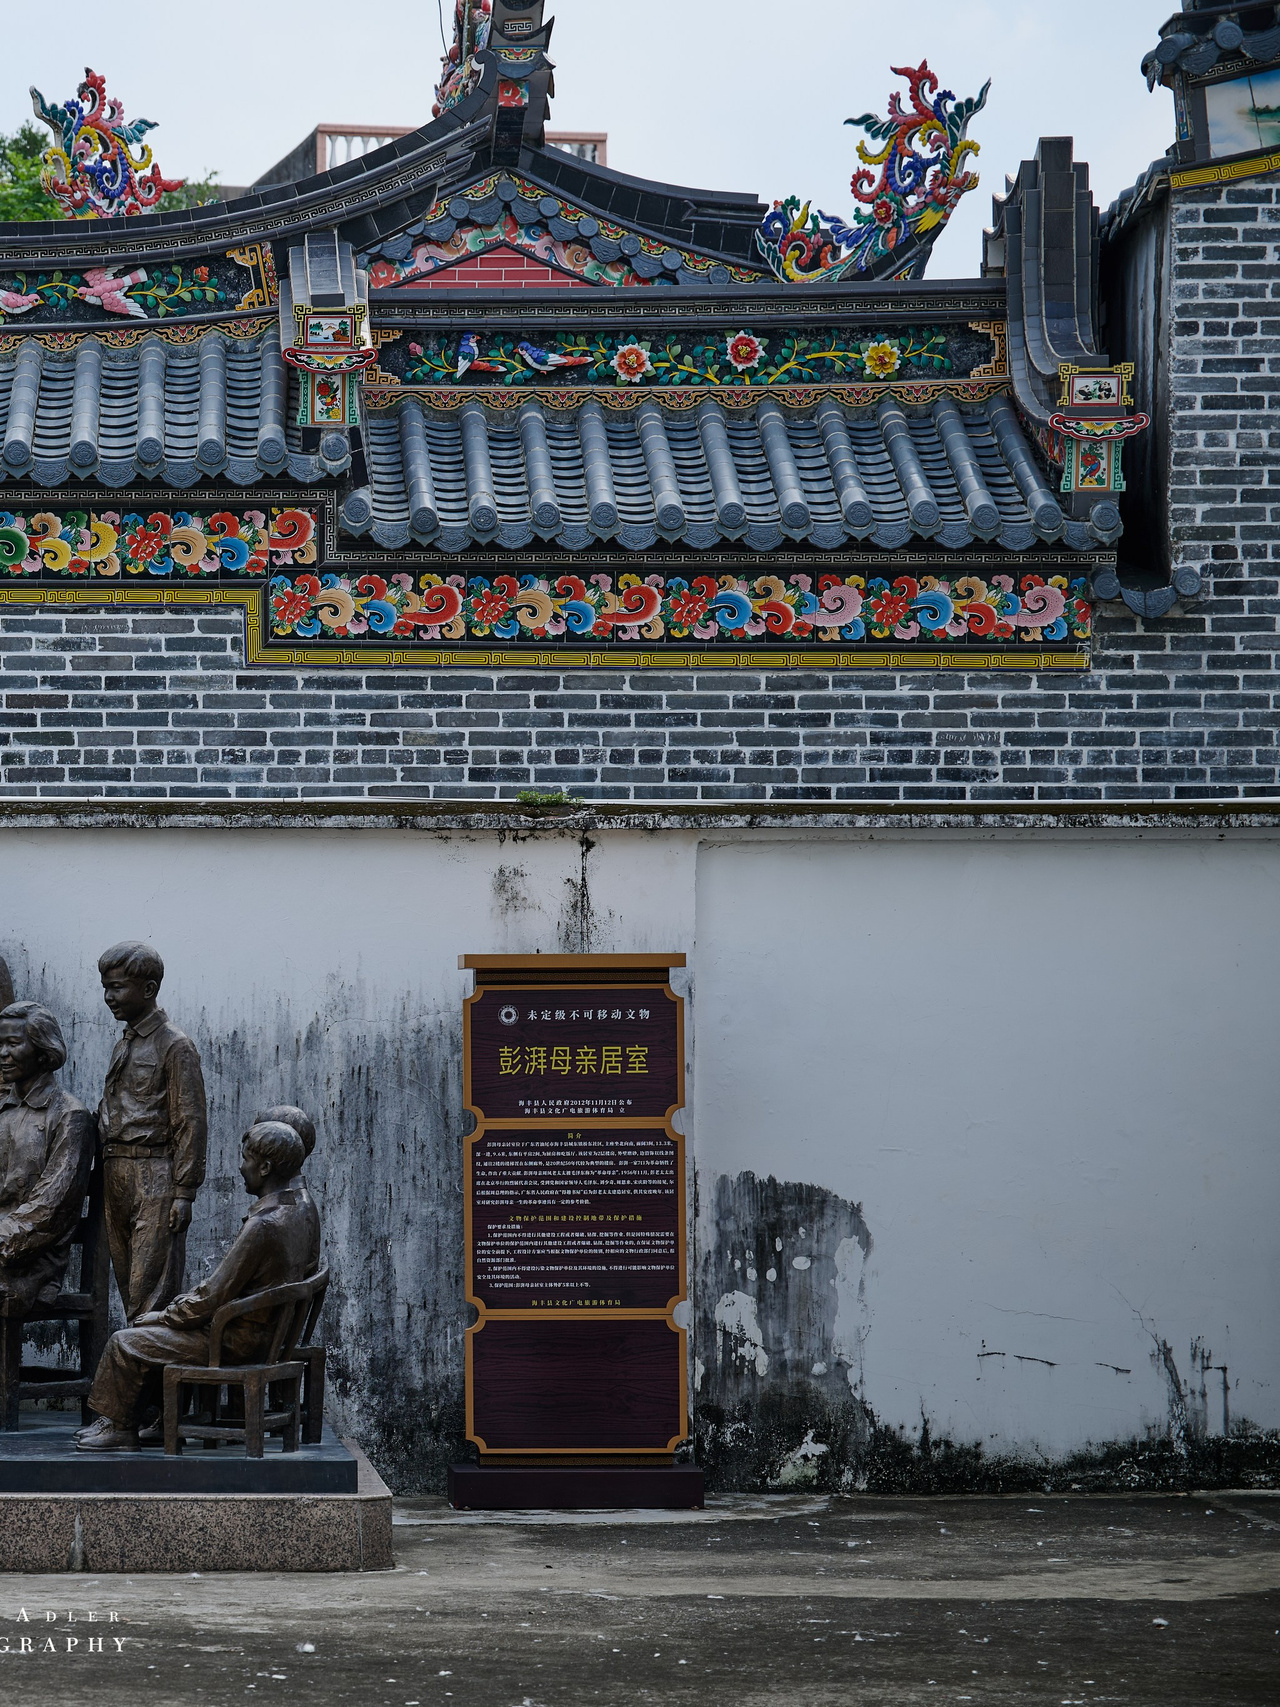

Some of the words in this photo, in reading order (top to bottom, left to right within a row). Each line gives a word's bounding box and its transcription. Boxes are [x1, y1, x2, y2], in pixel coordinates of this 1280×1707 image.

[527, 1008, 650, 1021] 未定级不可移动文物
[498, 1045, 649, 1075] 彭湃母亲居室
[518, 1099, 633, 1107] 海丰县人民政府2012年11月12日公布
